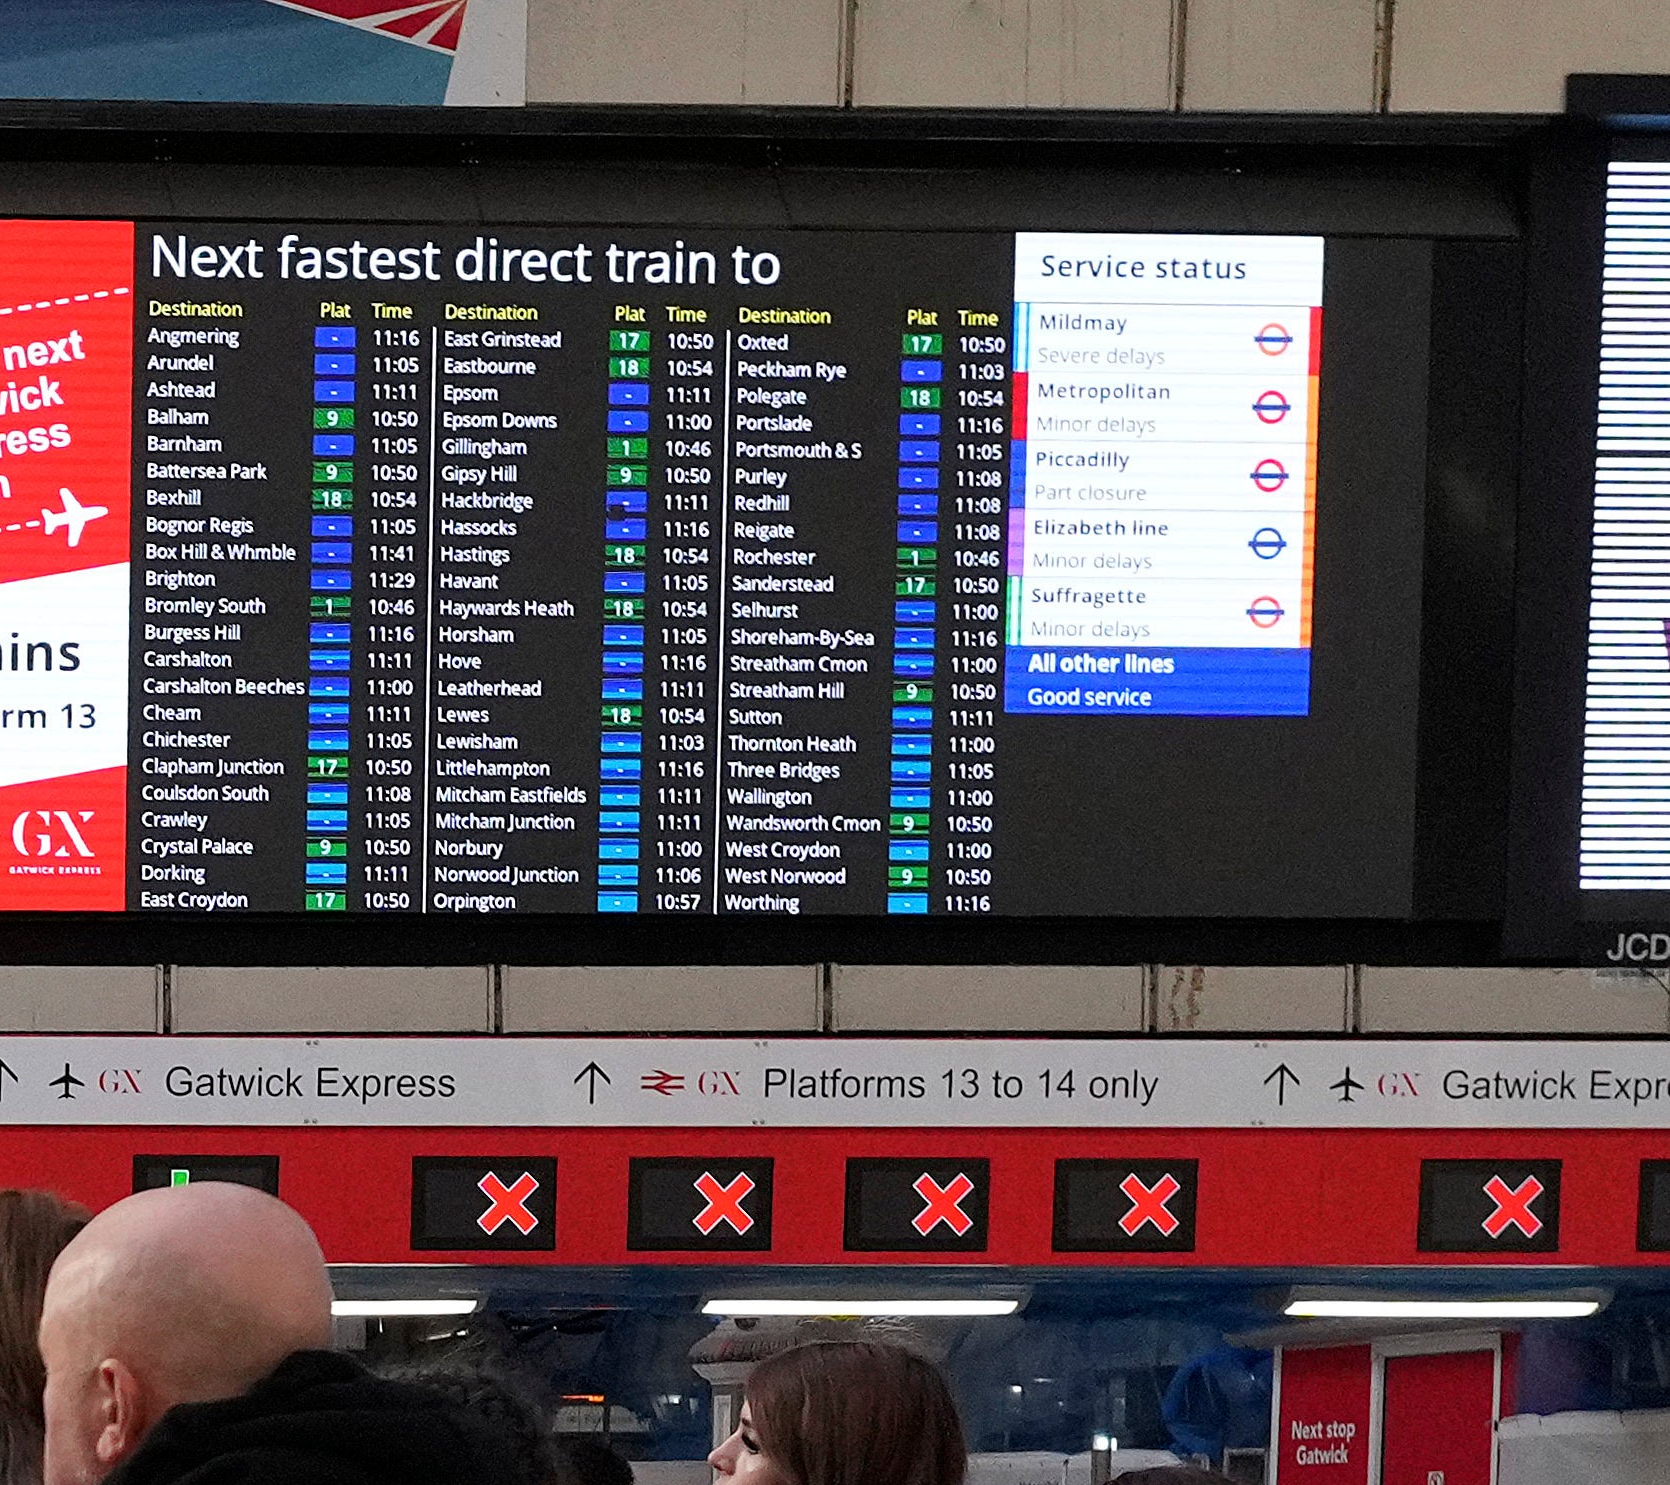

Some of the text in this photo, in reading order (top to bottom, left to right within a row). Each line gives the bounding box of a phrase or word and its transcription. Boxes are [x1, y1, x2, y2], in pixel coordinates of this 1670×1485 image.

[152, 234, 781, 285] Next fastest direct train to
[1041, 254, 1246, 280] Service status
[149, 300, 243, 317] Destination
[1039, 313, 1127, 336] Mildmay
[147, 327, 240, 349] Angmering
[373, 329, 420, 347] 11:16
[3, 329, 86, 371] next
[731, 628, 875, 651] Shoreham-By-Sea
[1028, 652, 1175, 674] All other lines
[1027, 687, 1152, 707] Good service
[61, 703, 96, 729] 13
[12, 810, 95, 857] GX
[165, 1065, 456, 1105] Gatwick Express
[764, 1067, 1159, 1107] Platforms 13 to 14 only
[1291, 1420, 1356, 1443] Next stop
[1296, 1444, 1349, 1466] Gatwick
